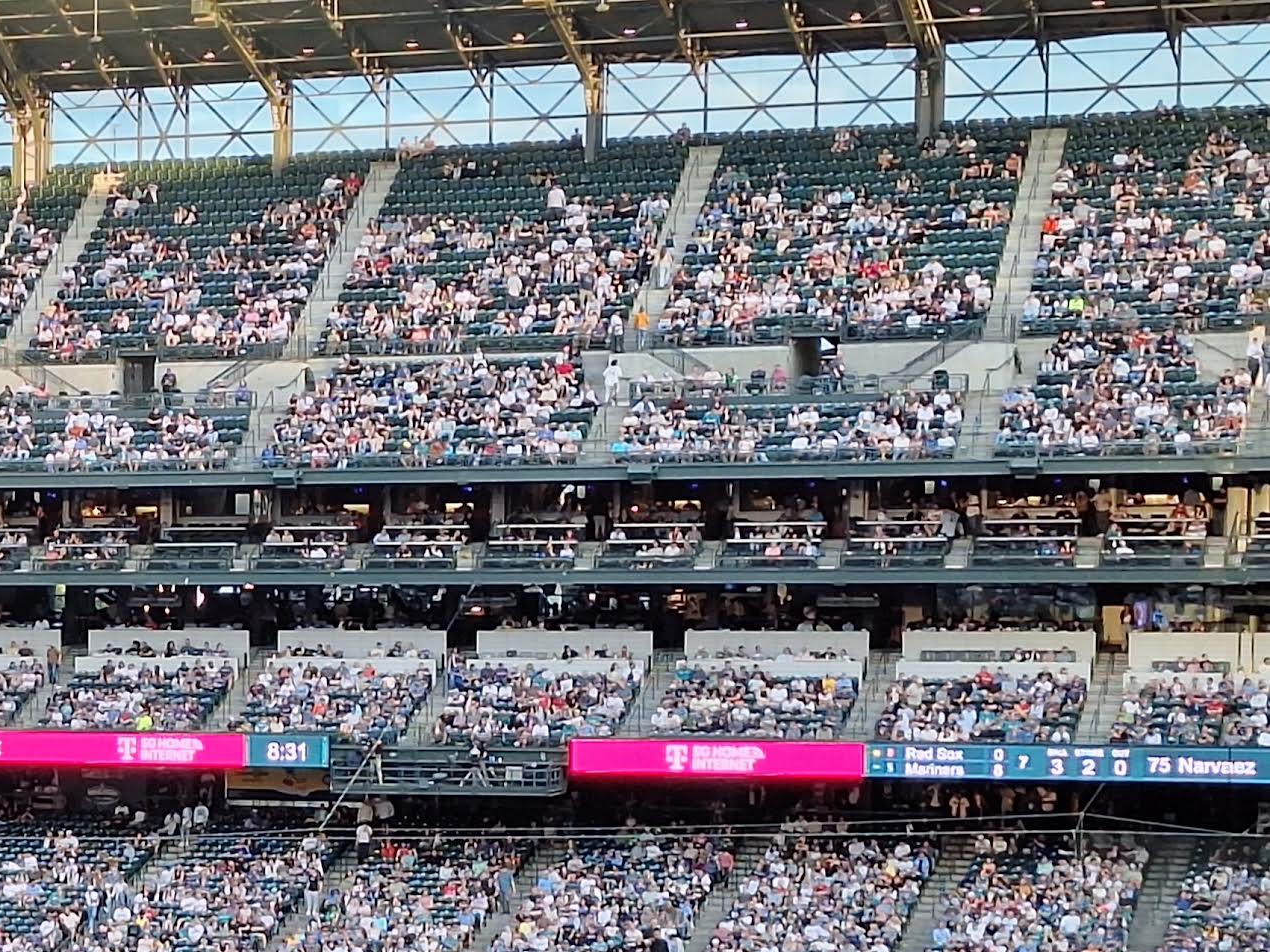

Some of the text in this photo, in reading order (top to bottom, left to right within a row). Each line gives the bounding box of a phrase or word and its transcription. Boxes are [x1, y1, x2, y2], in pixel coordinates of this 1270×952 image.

[141, 749, 195, 761] INTERNET
[267, 742, 307, 761] 8:31
[905, 747, 933, 761] Red
[936, 747, 964, 761] Sox
[993, 748, 1005, 762] 0
[692, 759, 757, 771] INTERNET
[905, 762, 965, 776] Mariners
[1018, 755, 1029, 769] 7
[1050, 758, 1127, 776] 3 2 0
[1147, 757, 1257, 776] 75 Narvaez
